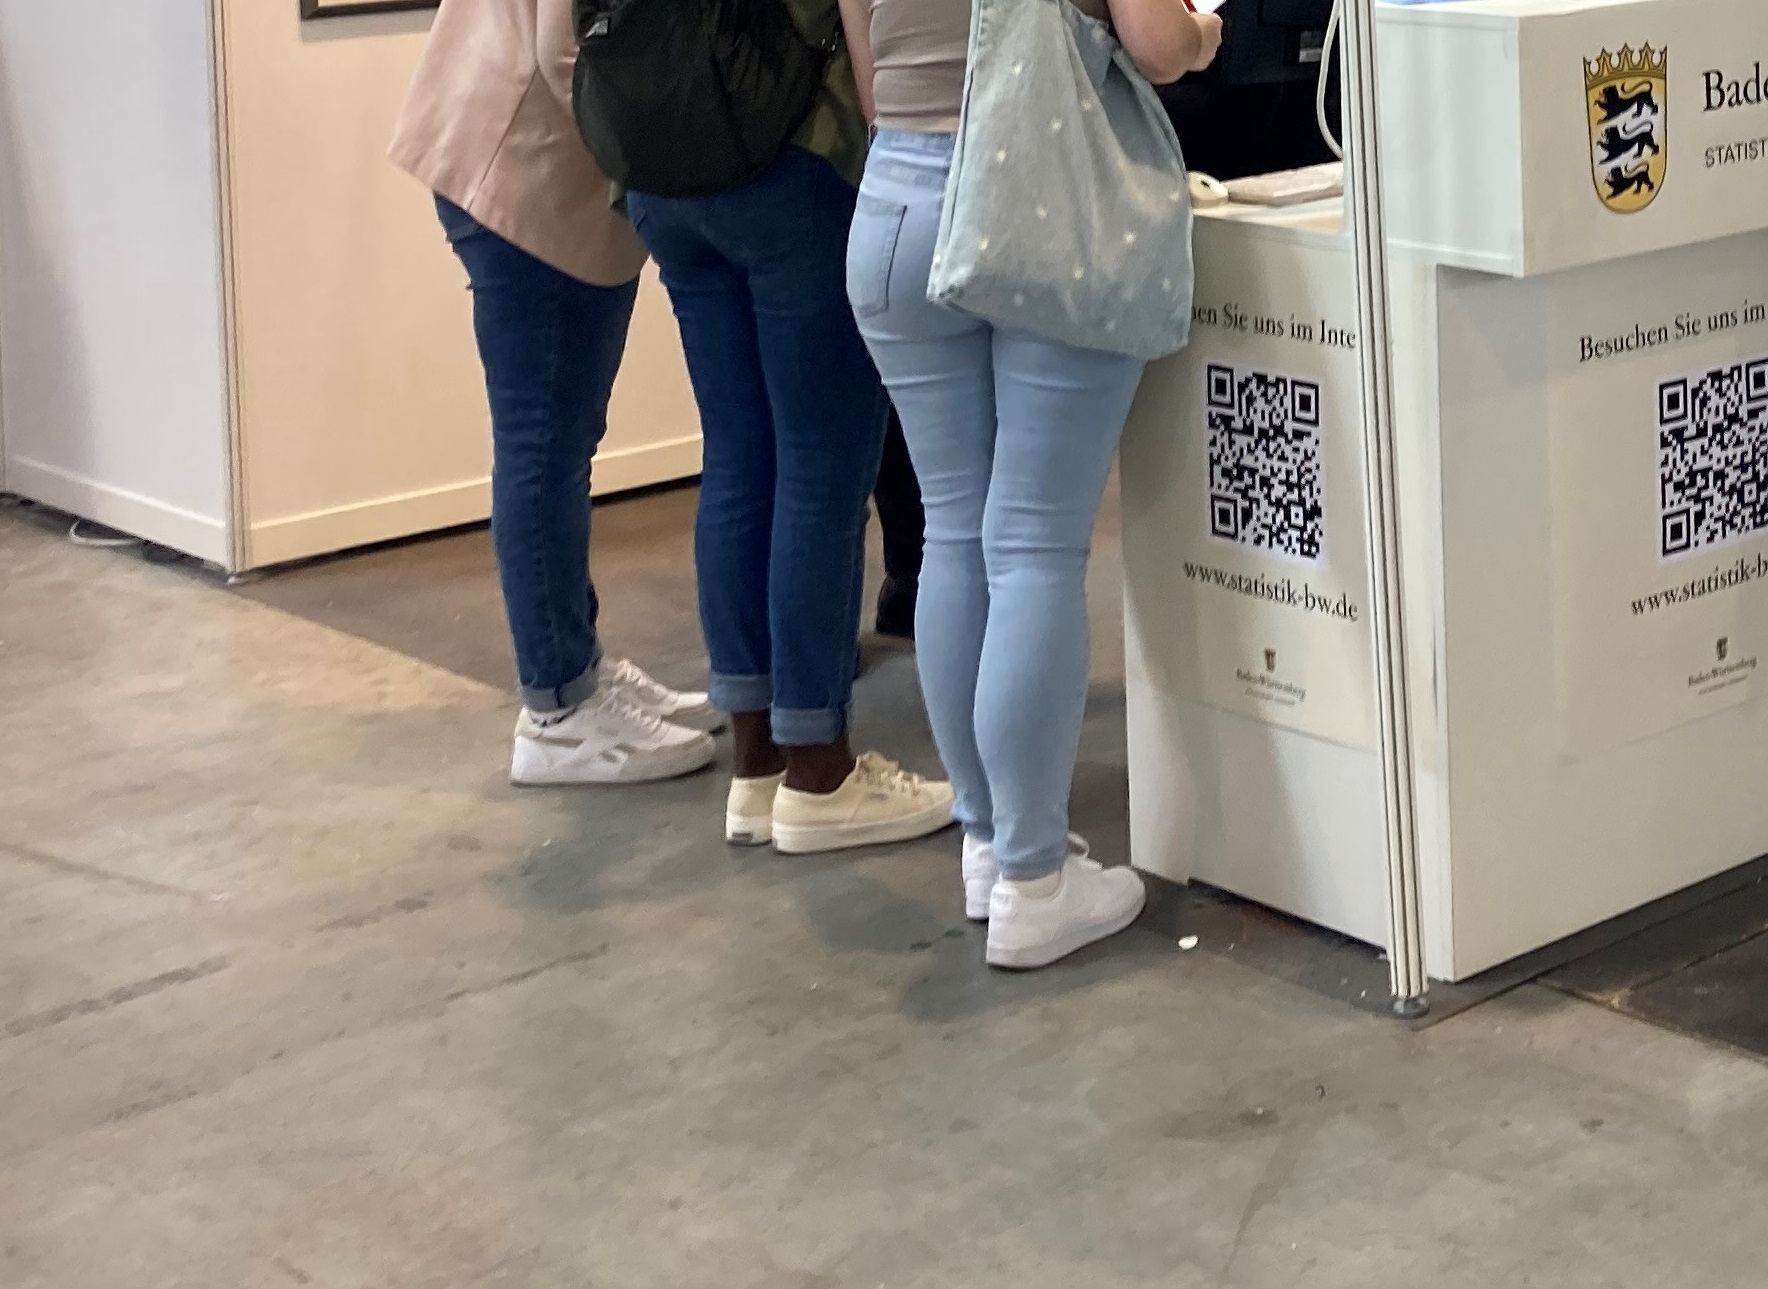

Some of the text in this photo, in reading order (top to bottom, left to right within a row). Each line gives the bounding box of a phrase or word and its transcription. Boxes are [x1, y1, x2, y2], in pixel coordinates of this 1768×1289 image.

[1222, 302, 1249, 331] Sie
[1253, 315, 1285, 337] uns
[1290, 313, 1313, 342] im
[1579, 323, 1669, 363] Besuchen
[1674, 312, 1702, 341] Sie
[1707, 309, 1738, 333] uns
[1743, 298, 1766, 326] im
[1183, 562, 1359, 622] www.statistik-bw.de
